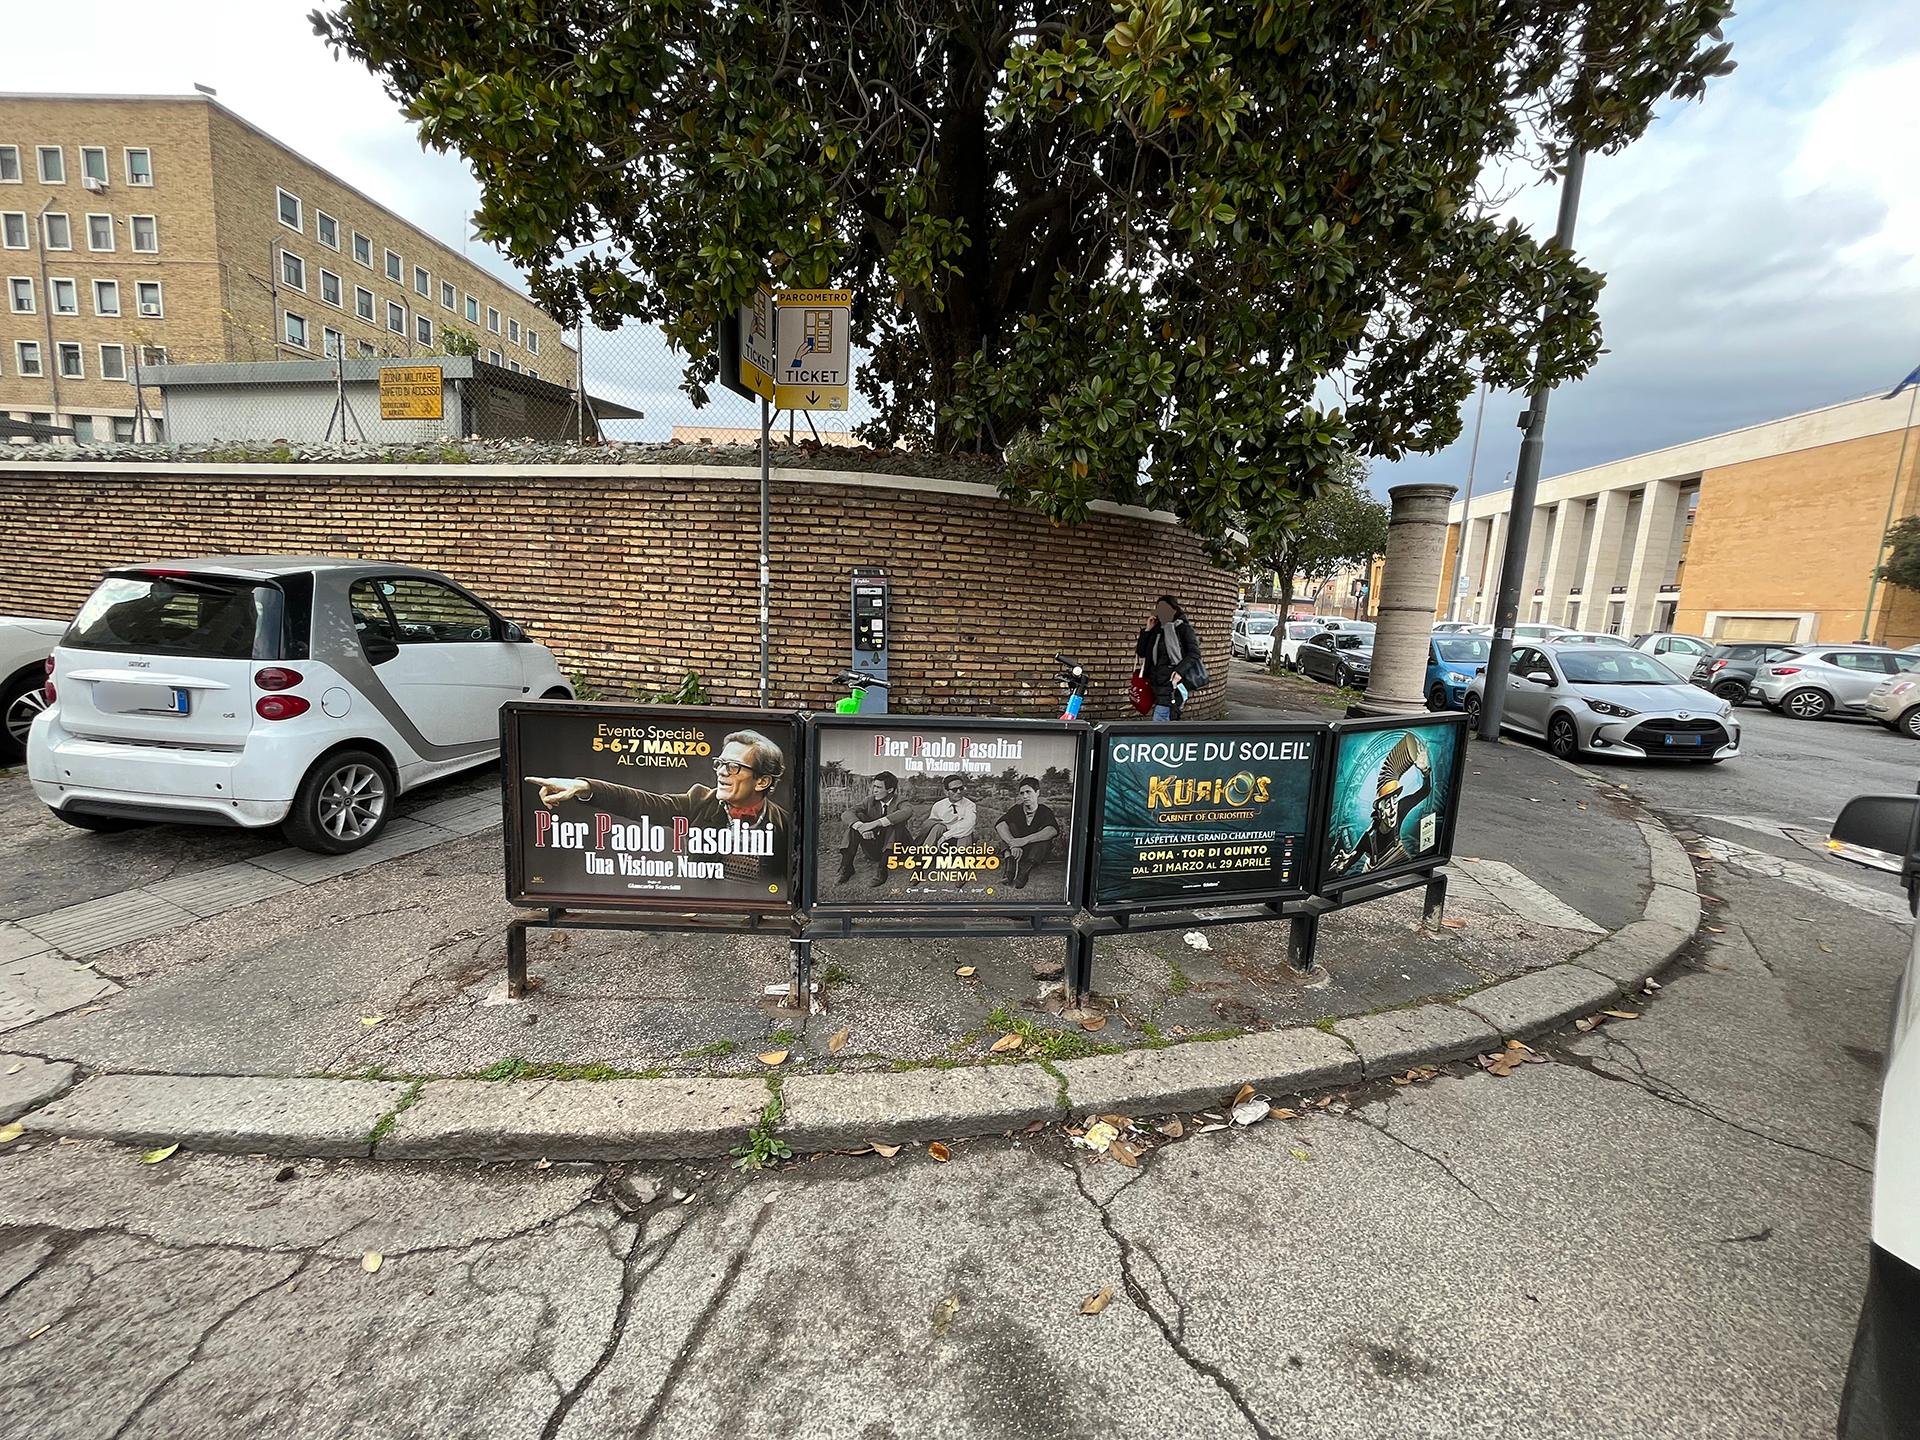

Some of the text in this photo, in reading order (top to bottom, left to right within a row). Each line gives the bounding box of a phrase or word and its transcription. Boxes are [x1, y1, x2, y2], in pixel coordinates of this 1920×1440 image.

[780, 293, 848, 302] PARCOMETRO
[745, 344, 770, 371] TICKET
[383, 372, 437, 383] ZONA MILITARE
[785, 370, 839, 383] TICKET
[412, 386, 440, 396] ACCESSO
[598, 723, 705, 742] Evento Speciale
[592, 737, 711, 757] 5-6-7 MARZO
[874, 735, 1023, 759] Pier Paolo Pasolini
[1112, 741, 1311, 768] CIRQUE DU SOLEIL
[617, 755, 688, 768] AL CINEMA
[904, 757, 991, 773] Una Visione Nuova
[1158, 811, 1254, 823] CABINET OF CURIOSITIES
[534, 810, 774, 857] Pier Paolo Pasolini
[1134, 831, 1276, 845] TI ASPETTA NEL GRAND CHAPITEAU!
[893, 842, 995, 859] Evento Speciale
[1139, 845, 1268, 861] ROMA TOR DI QUINTO
[585, 851, 724, 880] Una Visione Nuova
[886, 856, 1000, 870] 5-6-7 MARZO
[1132, 858, 1272, 875] DAL 21 MARZO AL 29 APRILE
[910, 871, 977, 881] AL CINEMA
